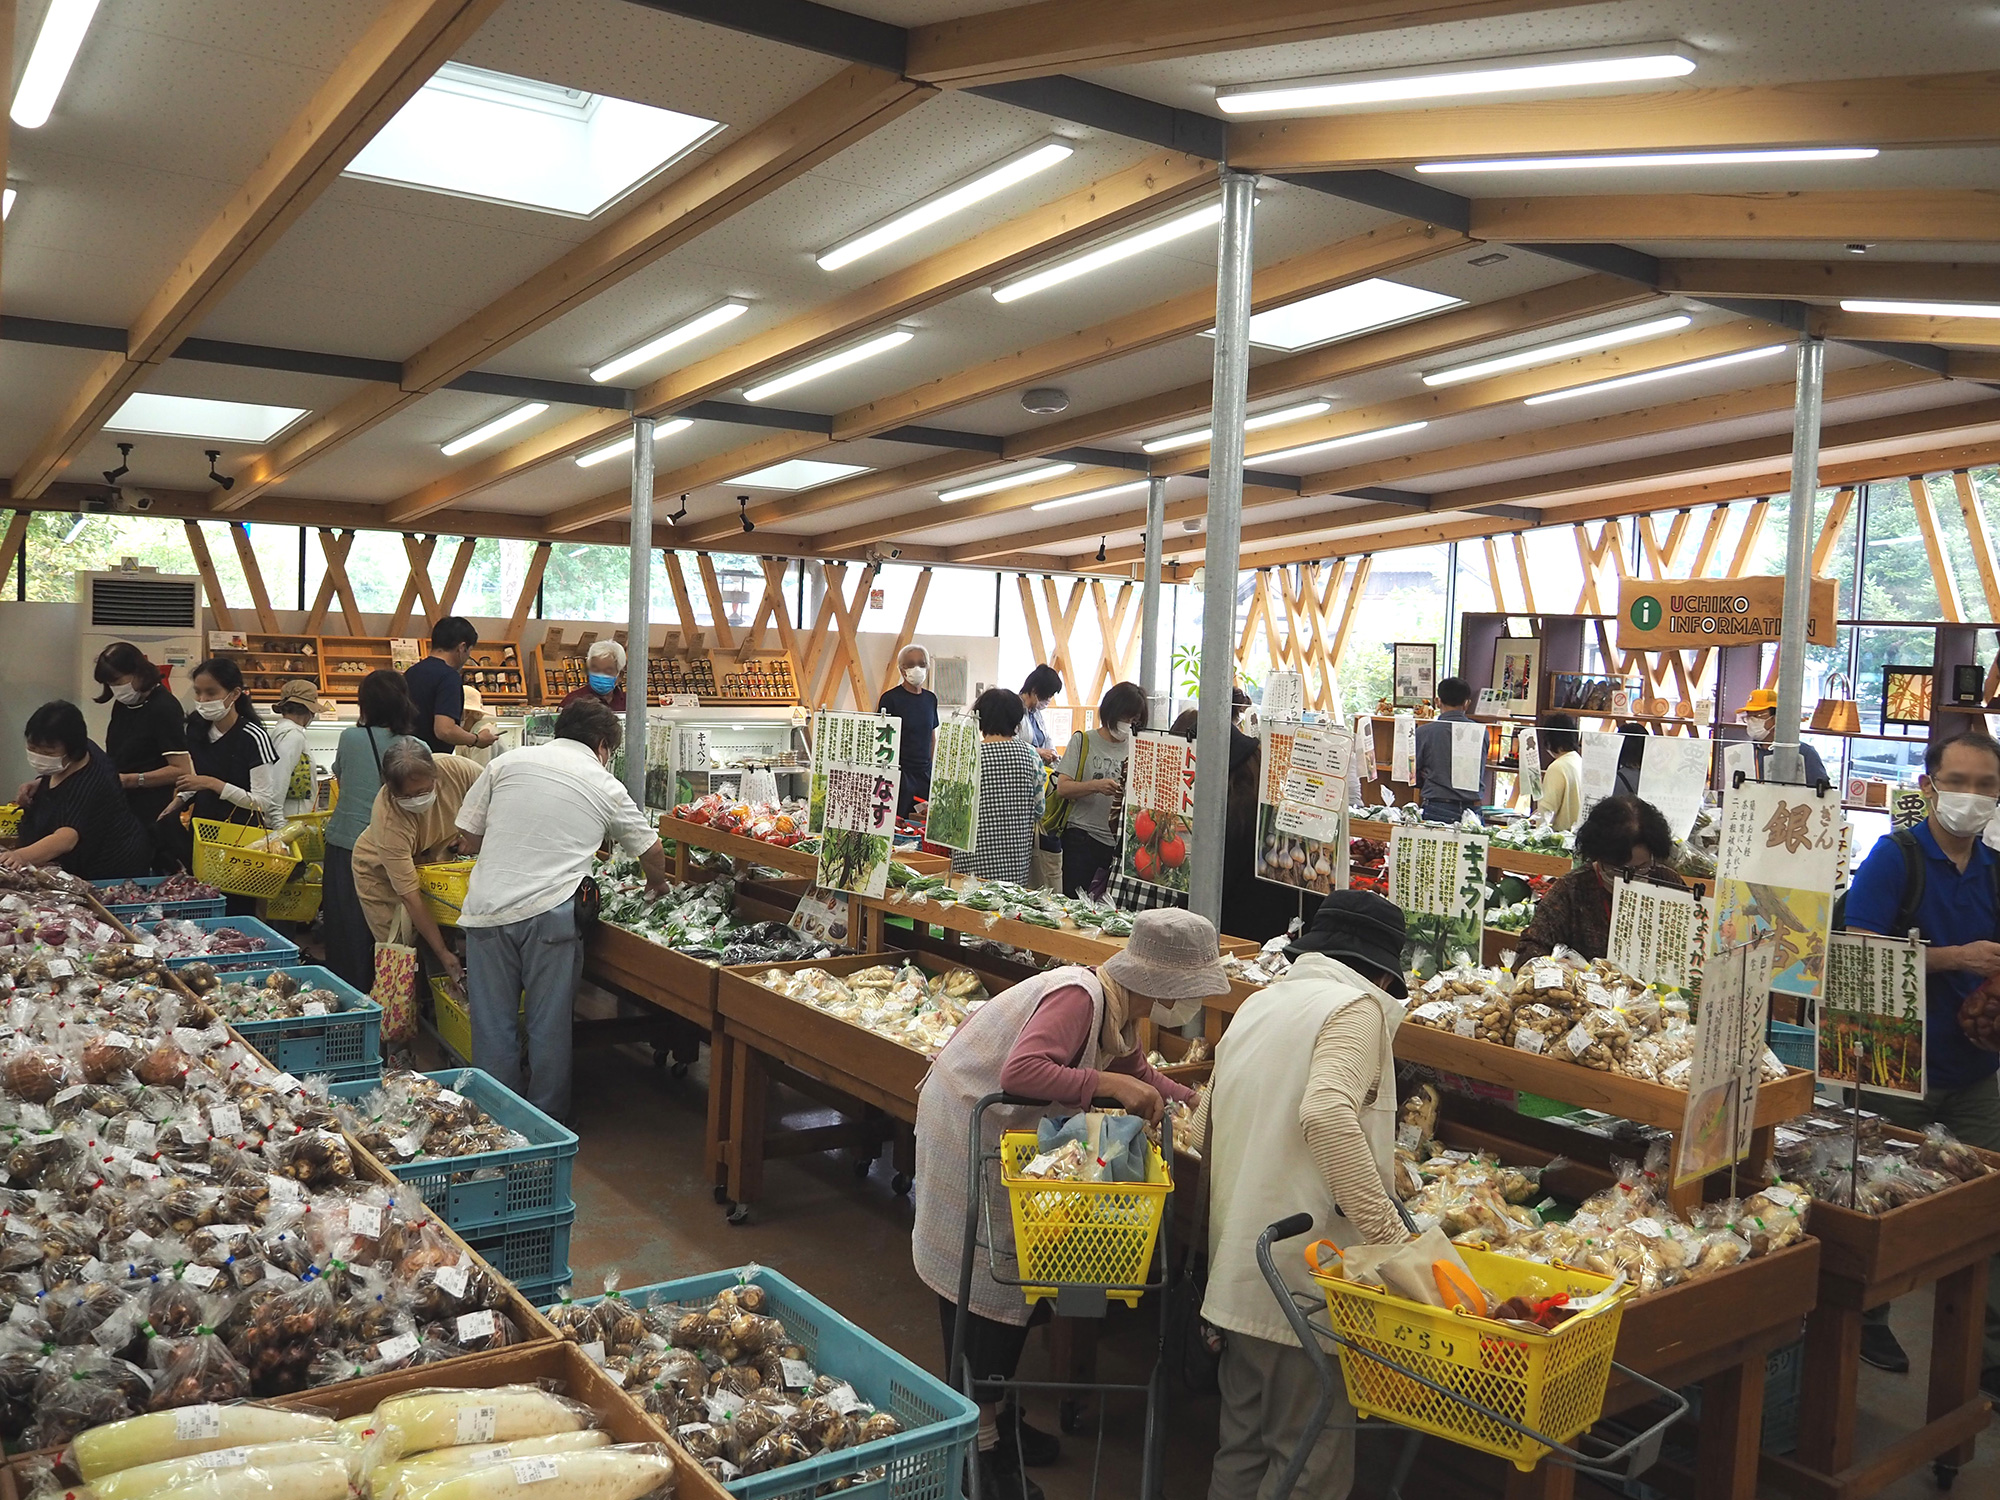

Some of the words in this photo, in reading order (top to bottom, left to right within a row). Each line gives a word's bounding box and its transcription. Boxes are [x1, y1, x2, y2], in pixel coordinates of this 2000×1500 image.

[1670, 596, 1749, 613] UCHIKO
[1670, 616, 1815, 636] INFORMATIN
[697, 732, 706, 767] キャベツ
[875, 723, 896, 768] オク
[1181, 746, 1197, 813] トマト
[871, 775, 894, 828] なす
[1892, 794, 1925, 828] 栗
[1814, 804, 1835, 850] ぎん
[229, 856, 265, 869] からり
[280, 889, 302, 897] らり
[430, 881, 449, 891] からり
[1459, 841, 1485, 933] キュウリ
[1901, 949, 1919, 1035] アスパラガス
[1393, 1324, 1454, 1357] からり
